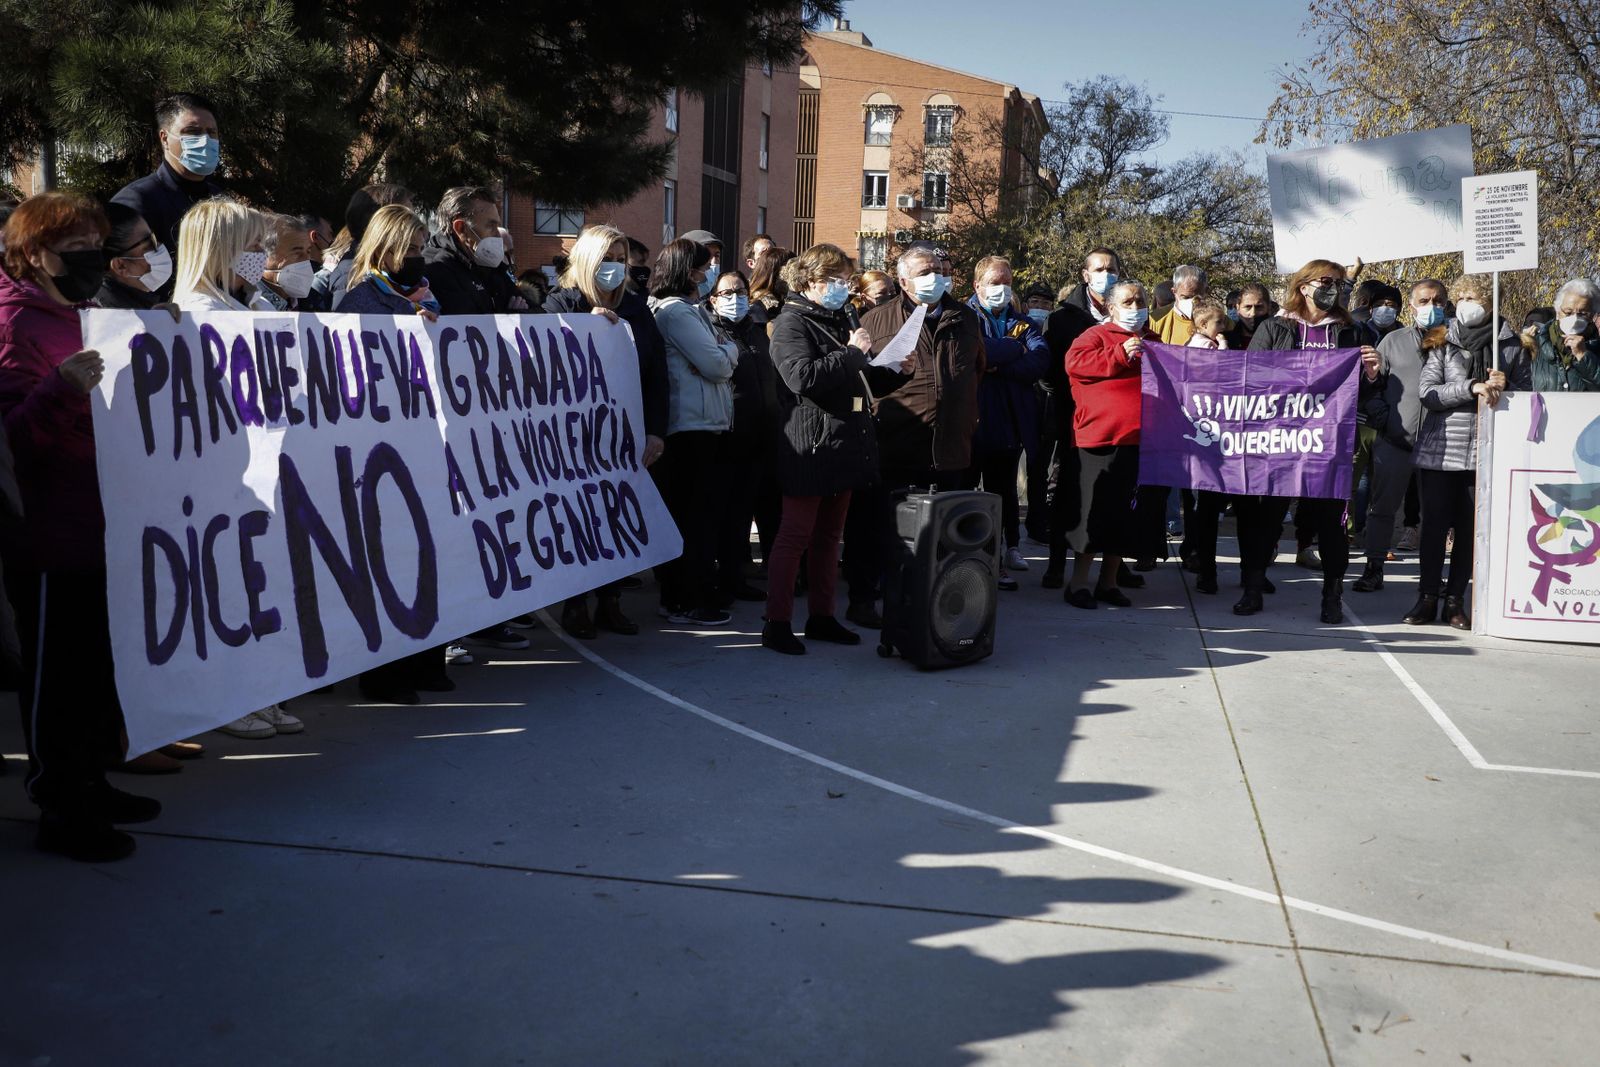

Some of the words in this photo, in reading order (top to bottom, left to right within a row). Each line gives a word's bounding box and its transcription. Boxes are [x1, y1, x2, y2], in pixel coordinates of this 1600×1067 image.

[1493, 185, 1500, 194] DE
[1501, 183, 1528, 192] NOVIEMBRE
[129, 323, 305, 461] PARQUE
[306, 326, 437, 429] NUEVA
[1223, 394, 1281, 421] VIVAS
[1283, 392, 1326, 419] NOS
[445, 441, 477, 516] A
[470, 420, 520, 500] LA
[1219, 427, 1324, 457] QUEREMOS
[279, 441, 440, 679] NO
[472, 509, 532, 599] DE
[526, 479, 649, 570] GENERO
[1510, 599, 1533, 614] LA
